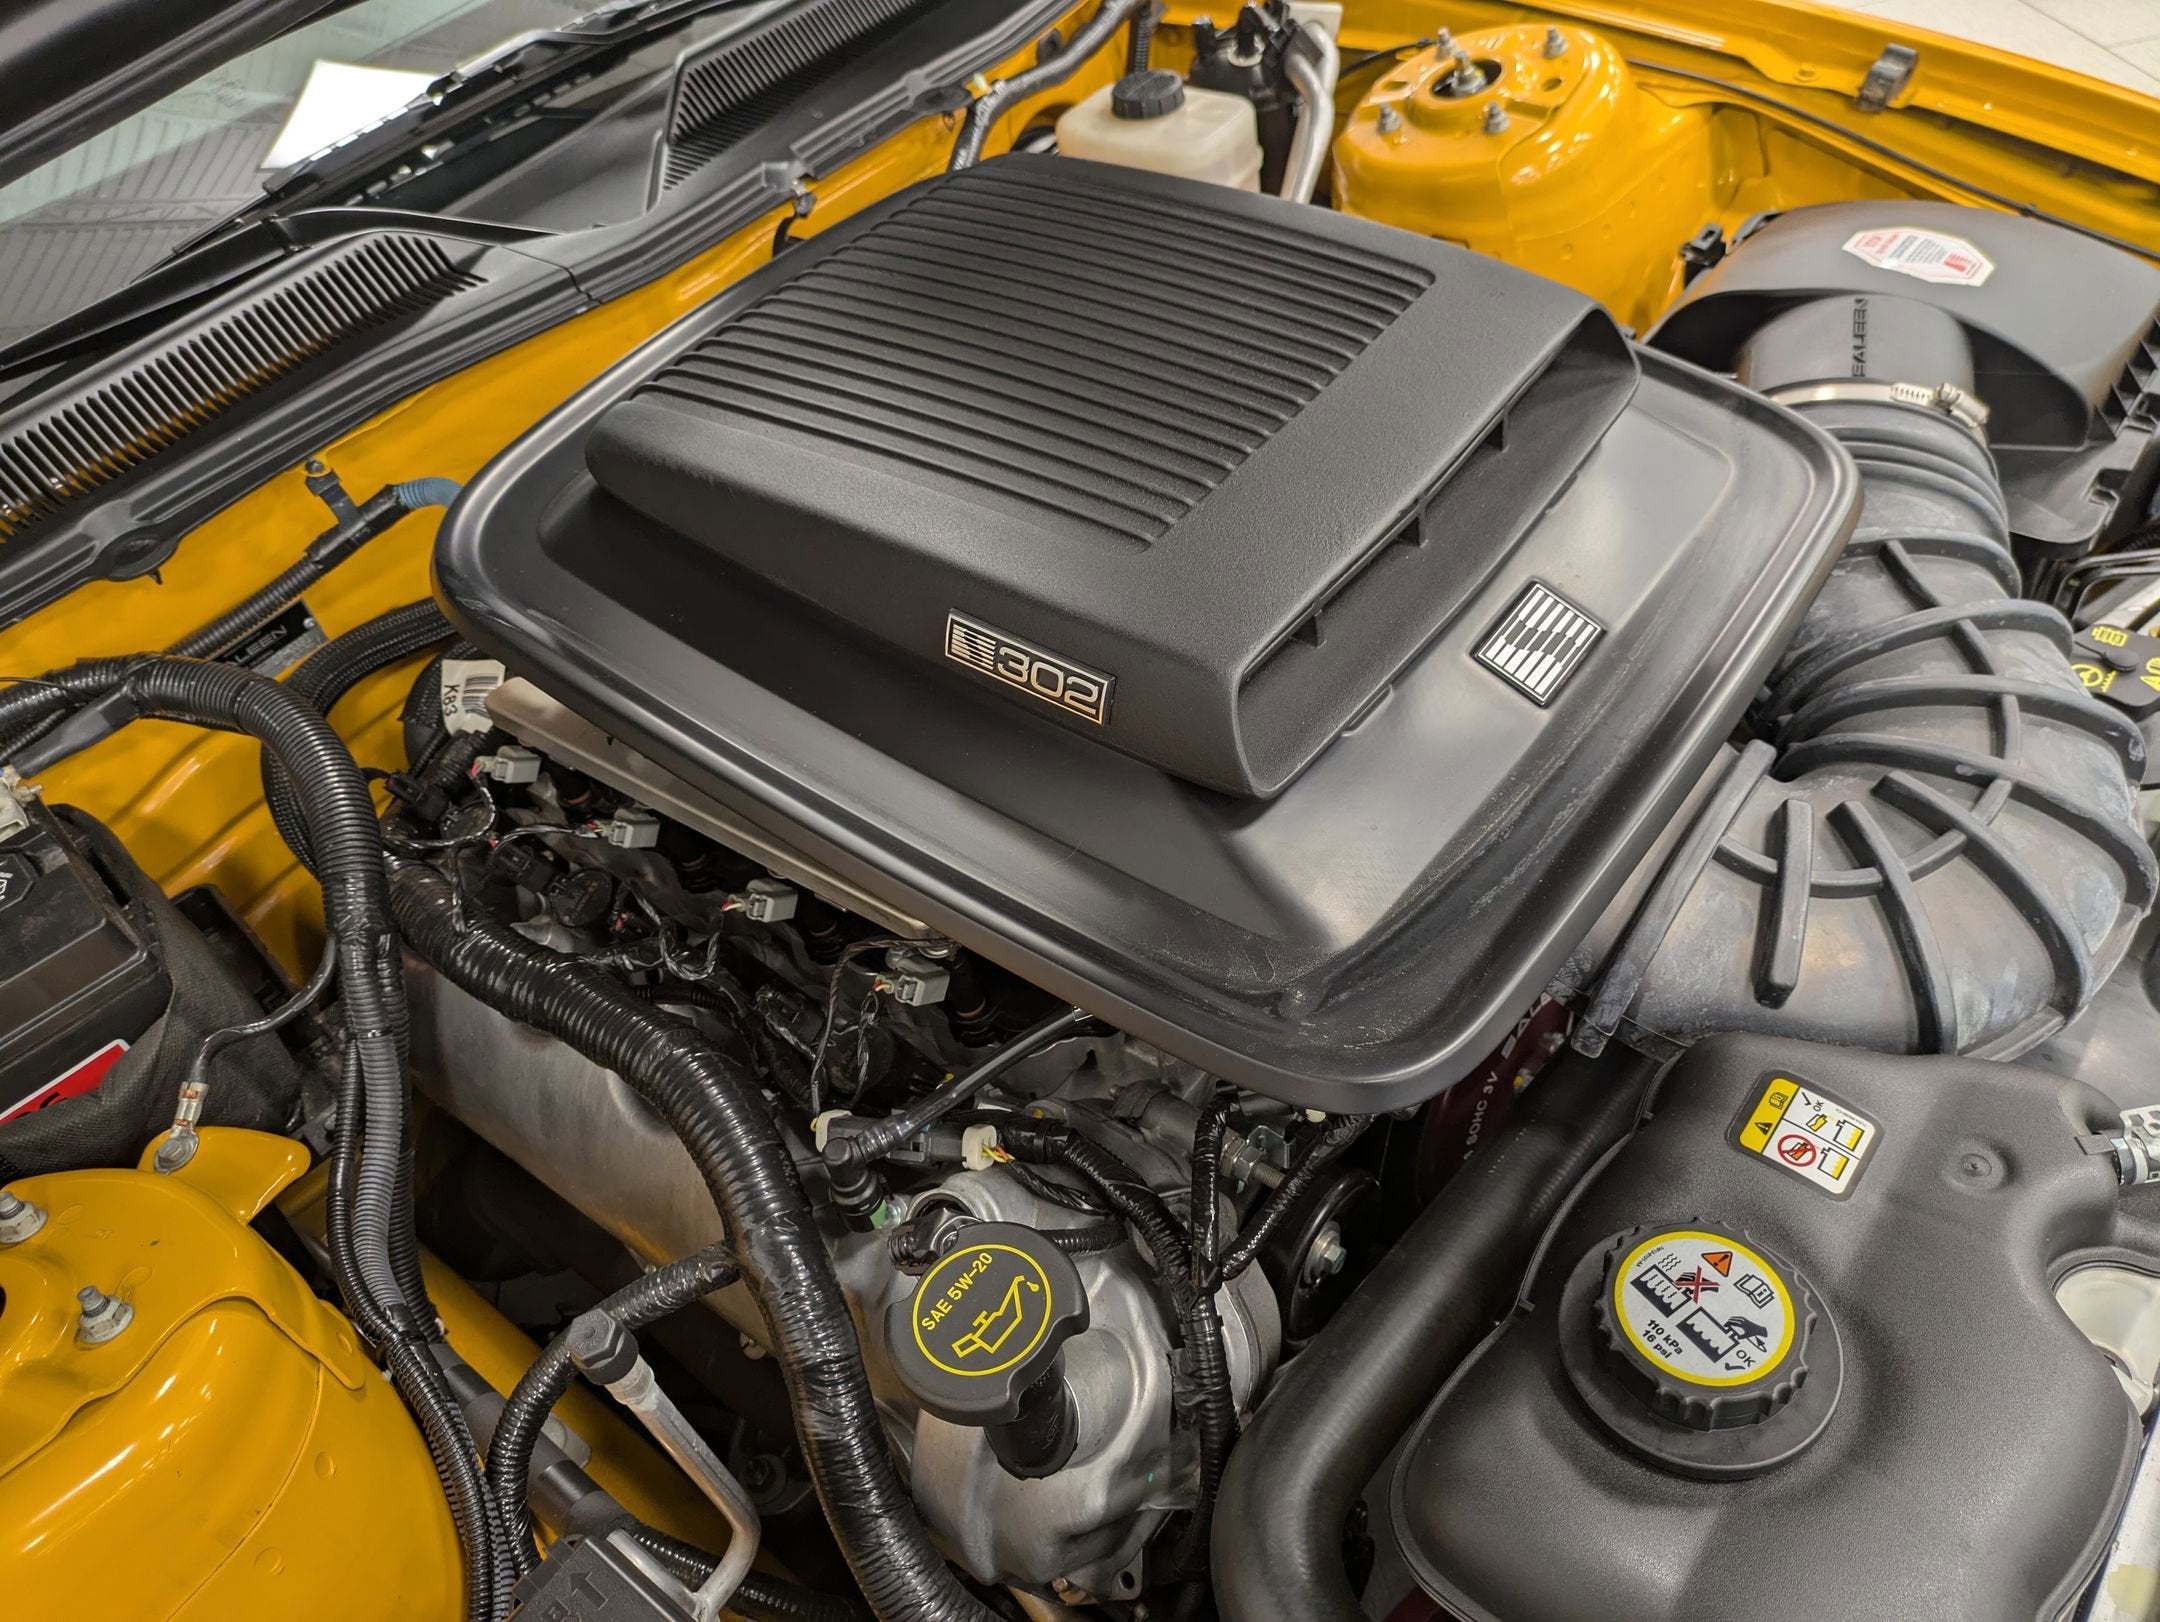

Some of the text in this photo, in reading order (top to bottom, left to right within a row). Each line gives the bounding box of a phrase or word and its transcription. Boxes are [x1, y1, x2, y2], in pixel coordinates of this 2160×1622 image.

[230, 624, 288, 665] LEEN
[997, 646, 1099, 715] 302
[443, 684, 461, 717] K83
[1466, 1100, 1487, 1146] SOHC
[1812, 1100, 1825, 1111] OK
[921, 1252, 993, 1331] SAE 5W-20
[1642, 1329, 1672, 1359] 16 psi
[1647, 1319, 1684, 1355] 110 kPa
[1736, 1349, 1756, 1368] OK
